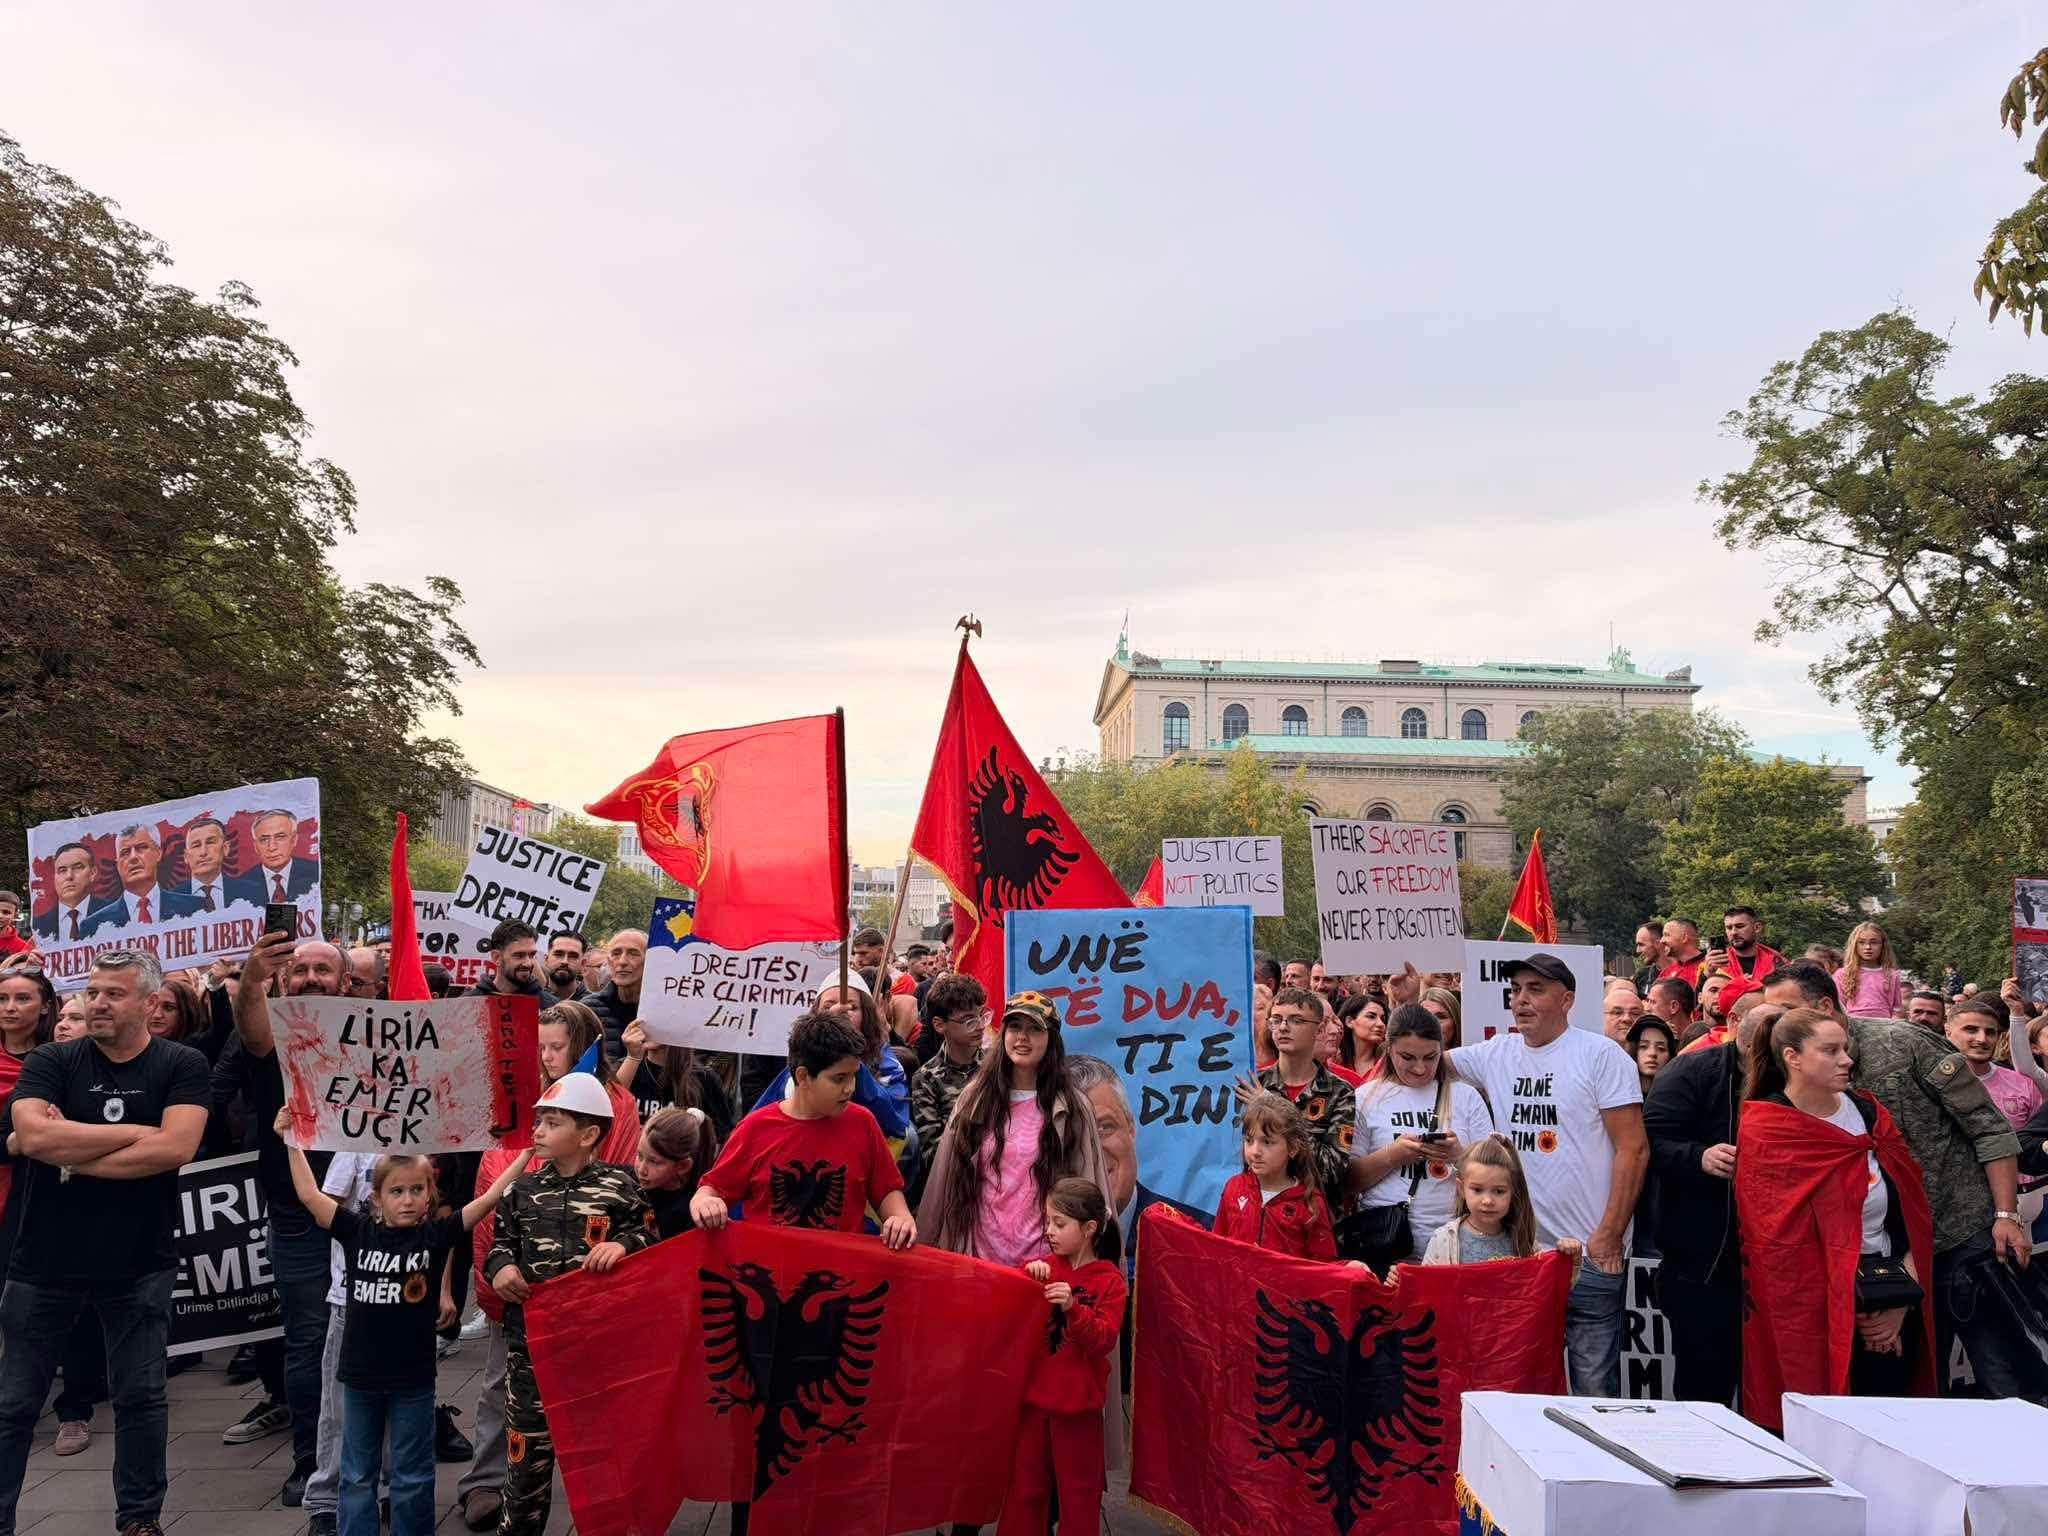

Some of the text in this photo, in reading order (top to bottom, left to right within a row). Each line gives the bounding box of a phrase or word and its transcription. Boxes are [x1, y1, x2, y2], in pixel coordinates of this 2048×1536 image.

[1165, 839, 1271, 863] JUSTICE
[1313, 825, 1448, 854] THEIR SACRIFICE
[476, 826, 600, 892] JUSTICE
[1165, 873, 1280, 895] NOT POLITICS
[1336, 864, 1455, 896] OUR FREEDOM
[454, 874, 585, 935] DREJTËSI
[164, 928, 197, 959] THE
[202, 908, 317, 954] LIBERARS
[1321, 907, 1464, 941] NEVER FORGOTTEN
[1027, 920, 1149, 976] UNË
[691, 953, 808, 984] DREJTËSI
[664, 975, 705, 998] PËR
[1121, 980, 1241, 1027] DUA,
[1116, 1032, 1235, 1075] TI E
[372, 1053, 409, 1087] KA
[1513, 1073, 1554, 1097] JO NË
[325, 1077, 432, 1116] EMËR
[341, 1108, 423, 1147] UÇK
[1391, 1111, 1415, 1128] JO
[357, 1249, 431, 1274] LIRIA KA
[353, 1277, 402, 1304] EMËR
[176, 1301, 215, 1316] Urime
